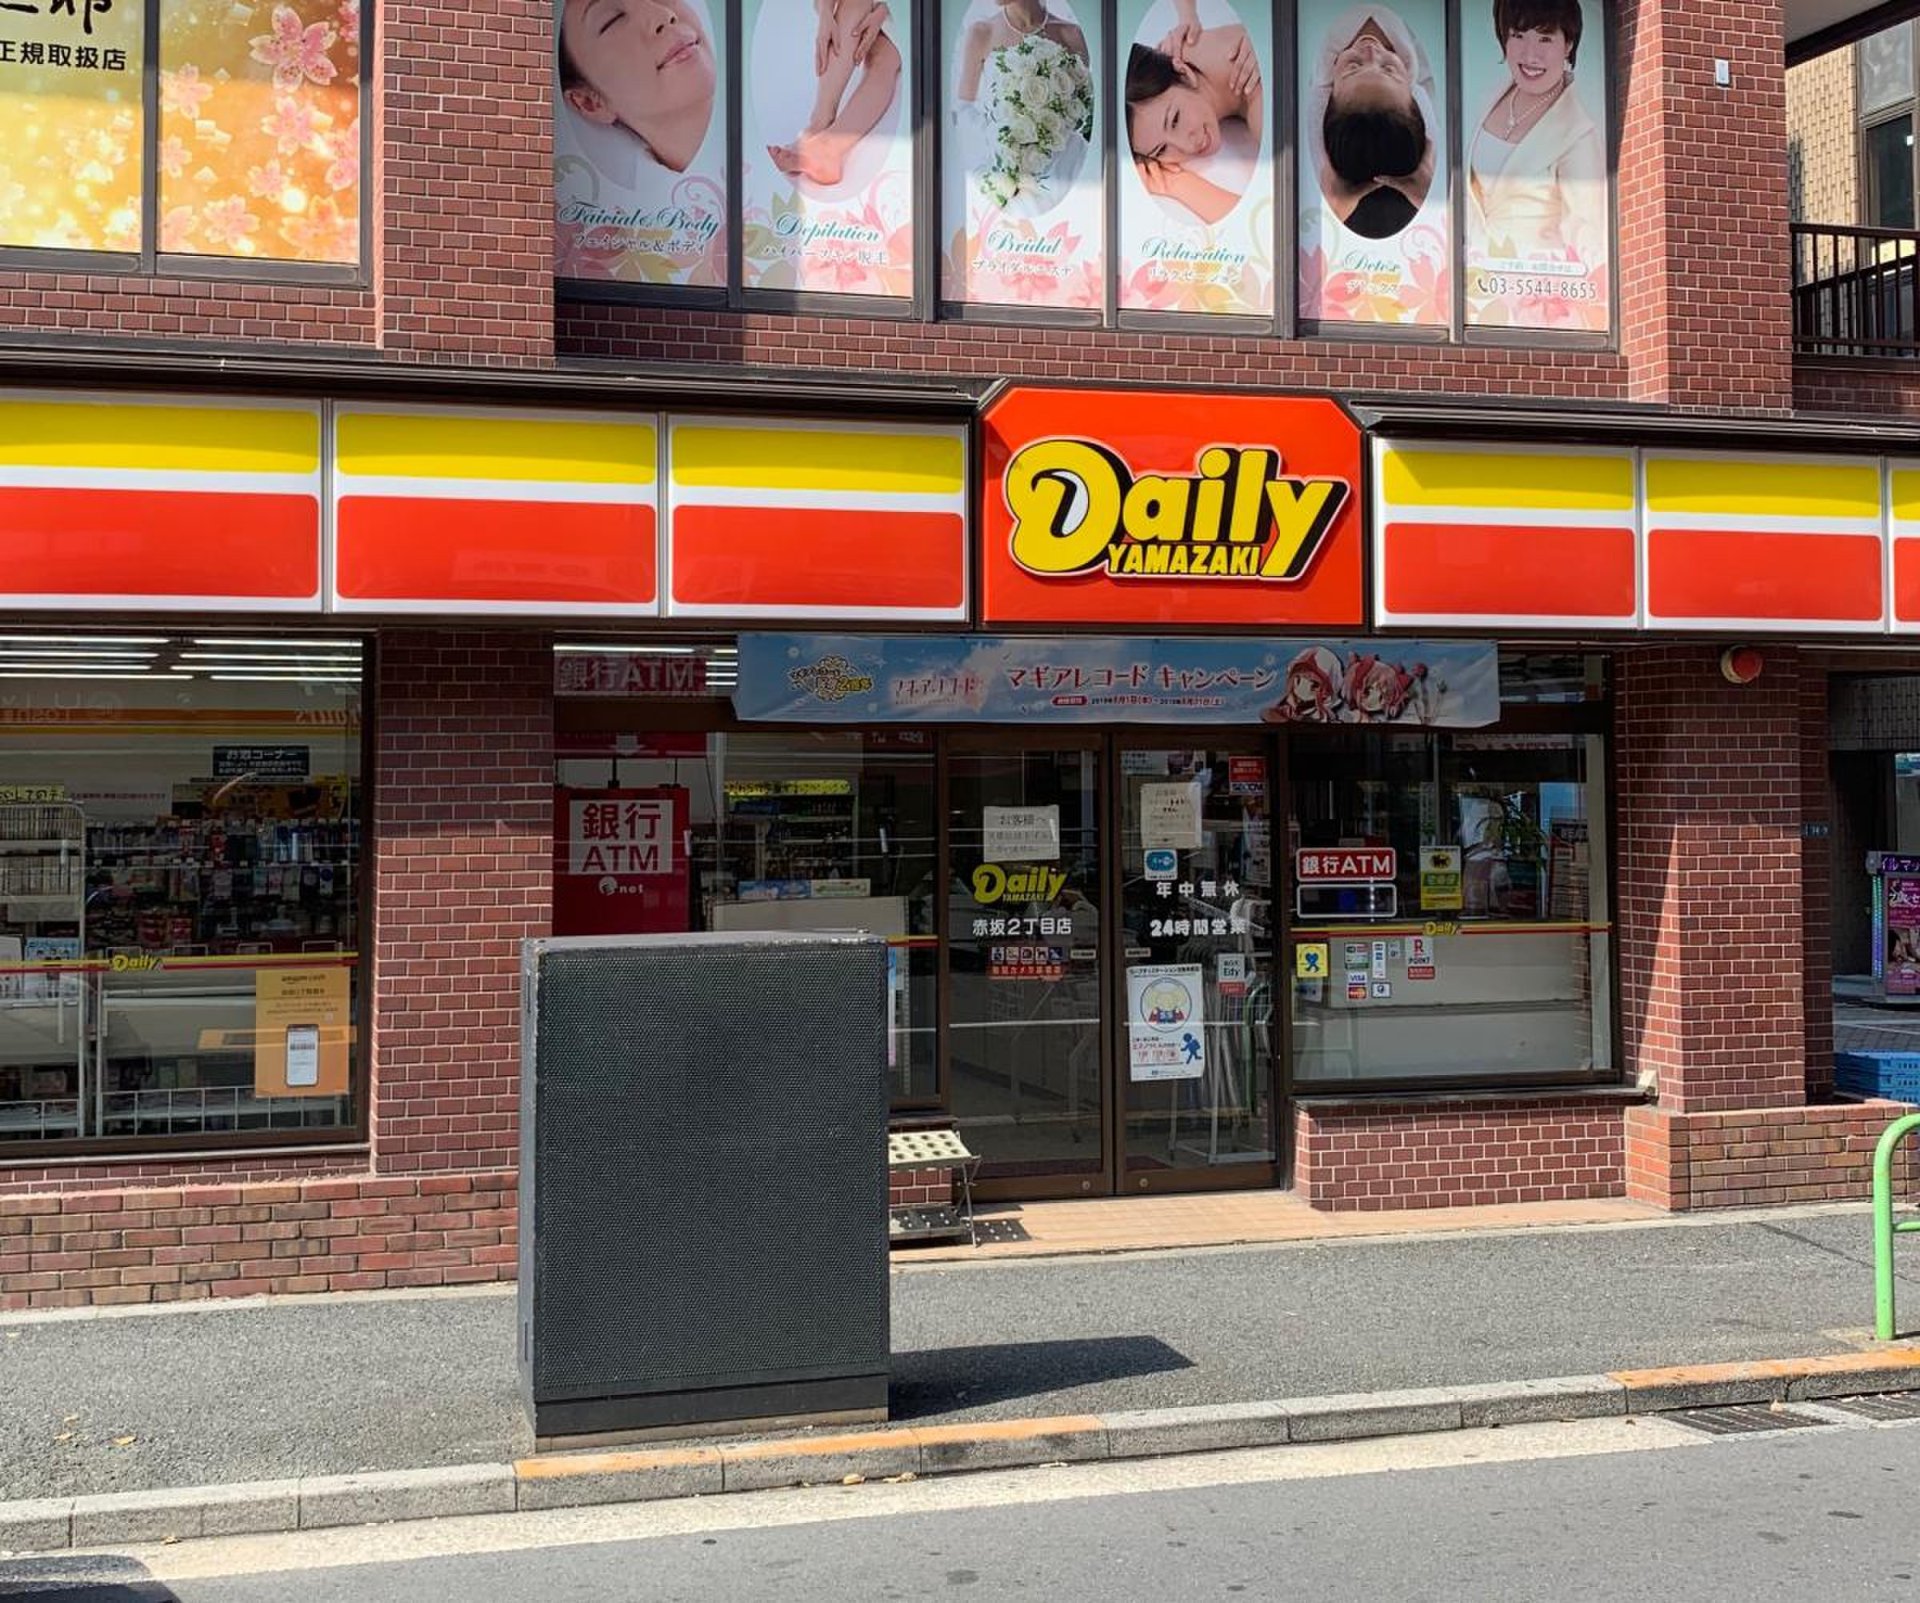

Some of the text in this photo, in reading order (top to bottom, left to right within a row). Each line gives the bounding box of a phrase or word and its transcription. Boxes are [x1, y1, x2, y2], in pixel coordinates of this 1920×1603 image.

[987, 230, 1062, 254] Bridal
[1141, 237, 1246, 264] Relaxation
[1488, 276, 1597, 299] 03-5544-8655
[1004, 437, 1350, 578] Daily
[1107, 543, 1261, 576] YAMAZAKI
[559, 659, 695, 690] 銀行ATM
[1007, 665, 1278, 691] マギアレコード キャンペーン
[582, 802, 662, 841] 銀行
[582, 845, 660, 872] ATM
[1302, 853, 1391, 875] 銀行ATM
[971, 863, 1069, 904] Daily
[1156, 881, 1241, 898] 年中無休
[972, 918, 1072, 936] 赤坂2丁目店
[1150, 918, 1246, 937] 24時間営業
[112, 954, 158, 972] Daily
[1350, 974, 1366, 982] VISA
